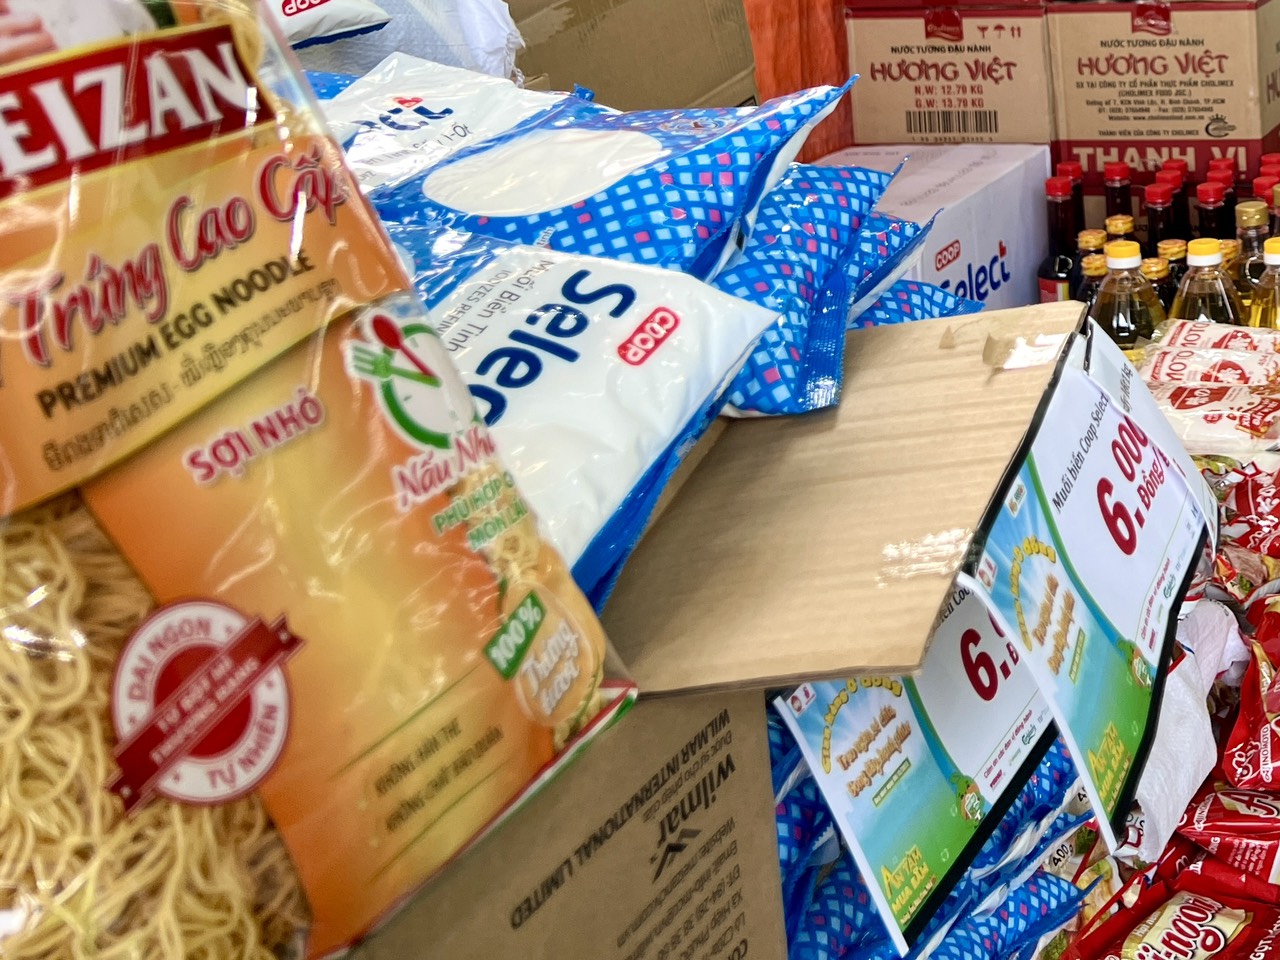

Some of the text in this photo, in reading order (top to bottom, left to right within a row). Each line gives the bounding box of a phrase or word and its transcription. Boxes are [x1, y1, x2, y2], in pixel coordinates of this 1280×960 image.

[870, 55, 1017, 85] HƯƠNG VIỆT
[891, 45, 915, 54] NƯỚC
[967, 44, 991, 53] NÀNH
[1077, 49, 1230, 78] HƯƠNG VIỆT
[971, 85, 983, 95] KG
[972, 98, 984, 108] KG
[1072, 146, 1196, 172] THANH
[8, 243, 165, 367] Trứng
[167, 197, 255, 271] Cao
[260, 144, 350, 228] Cấp
[936, 240, 960, 270] COOP
[477, 289, 523, 320] Biển
[36, 323, 175, 419] PREMIUM
[164, 298, 216, 353] EGG
[211, 249, 317, 313] NOODLE
[448, 317, 489, 353] Tinh
[624, 310, 677, 363] COOP
[186, 424, 259, 483] SỢI
[253, 389, 325, 452] NHỎ
[1053, 478, 1073, 513] Muối
[1069, 455, 1085, 480] biển
[1079, 422, 1098, 459] Coop
[148, 618, 211, 653] NGON
[490, 596, 543, 671] 100%
[681, 708, 730, 768] WILMAR
[574, 757, 680, 866] INTERNATIONAL
[657, 754, 736, 848] wilmar
[510, 858, 575, 929] LIMITED
